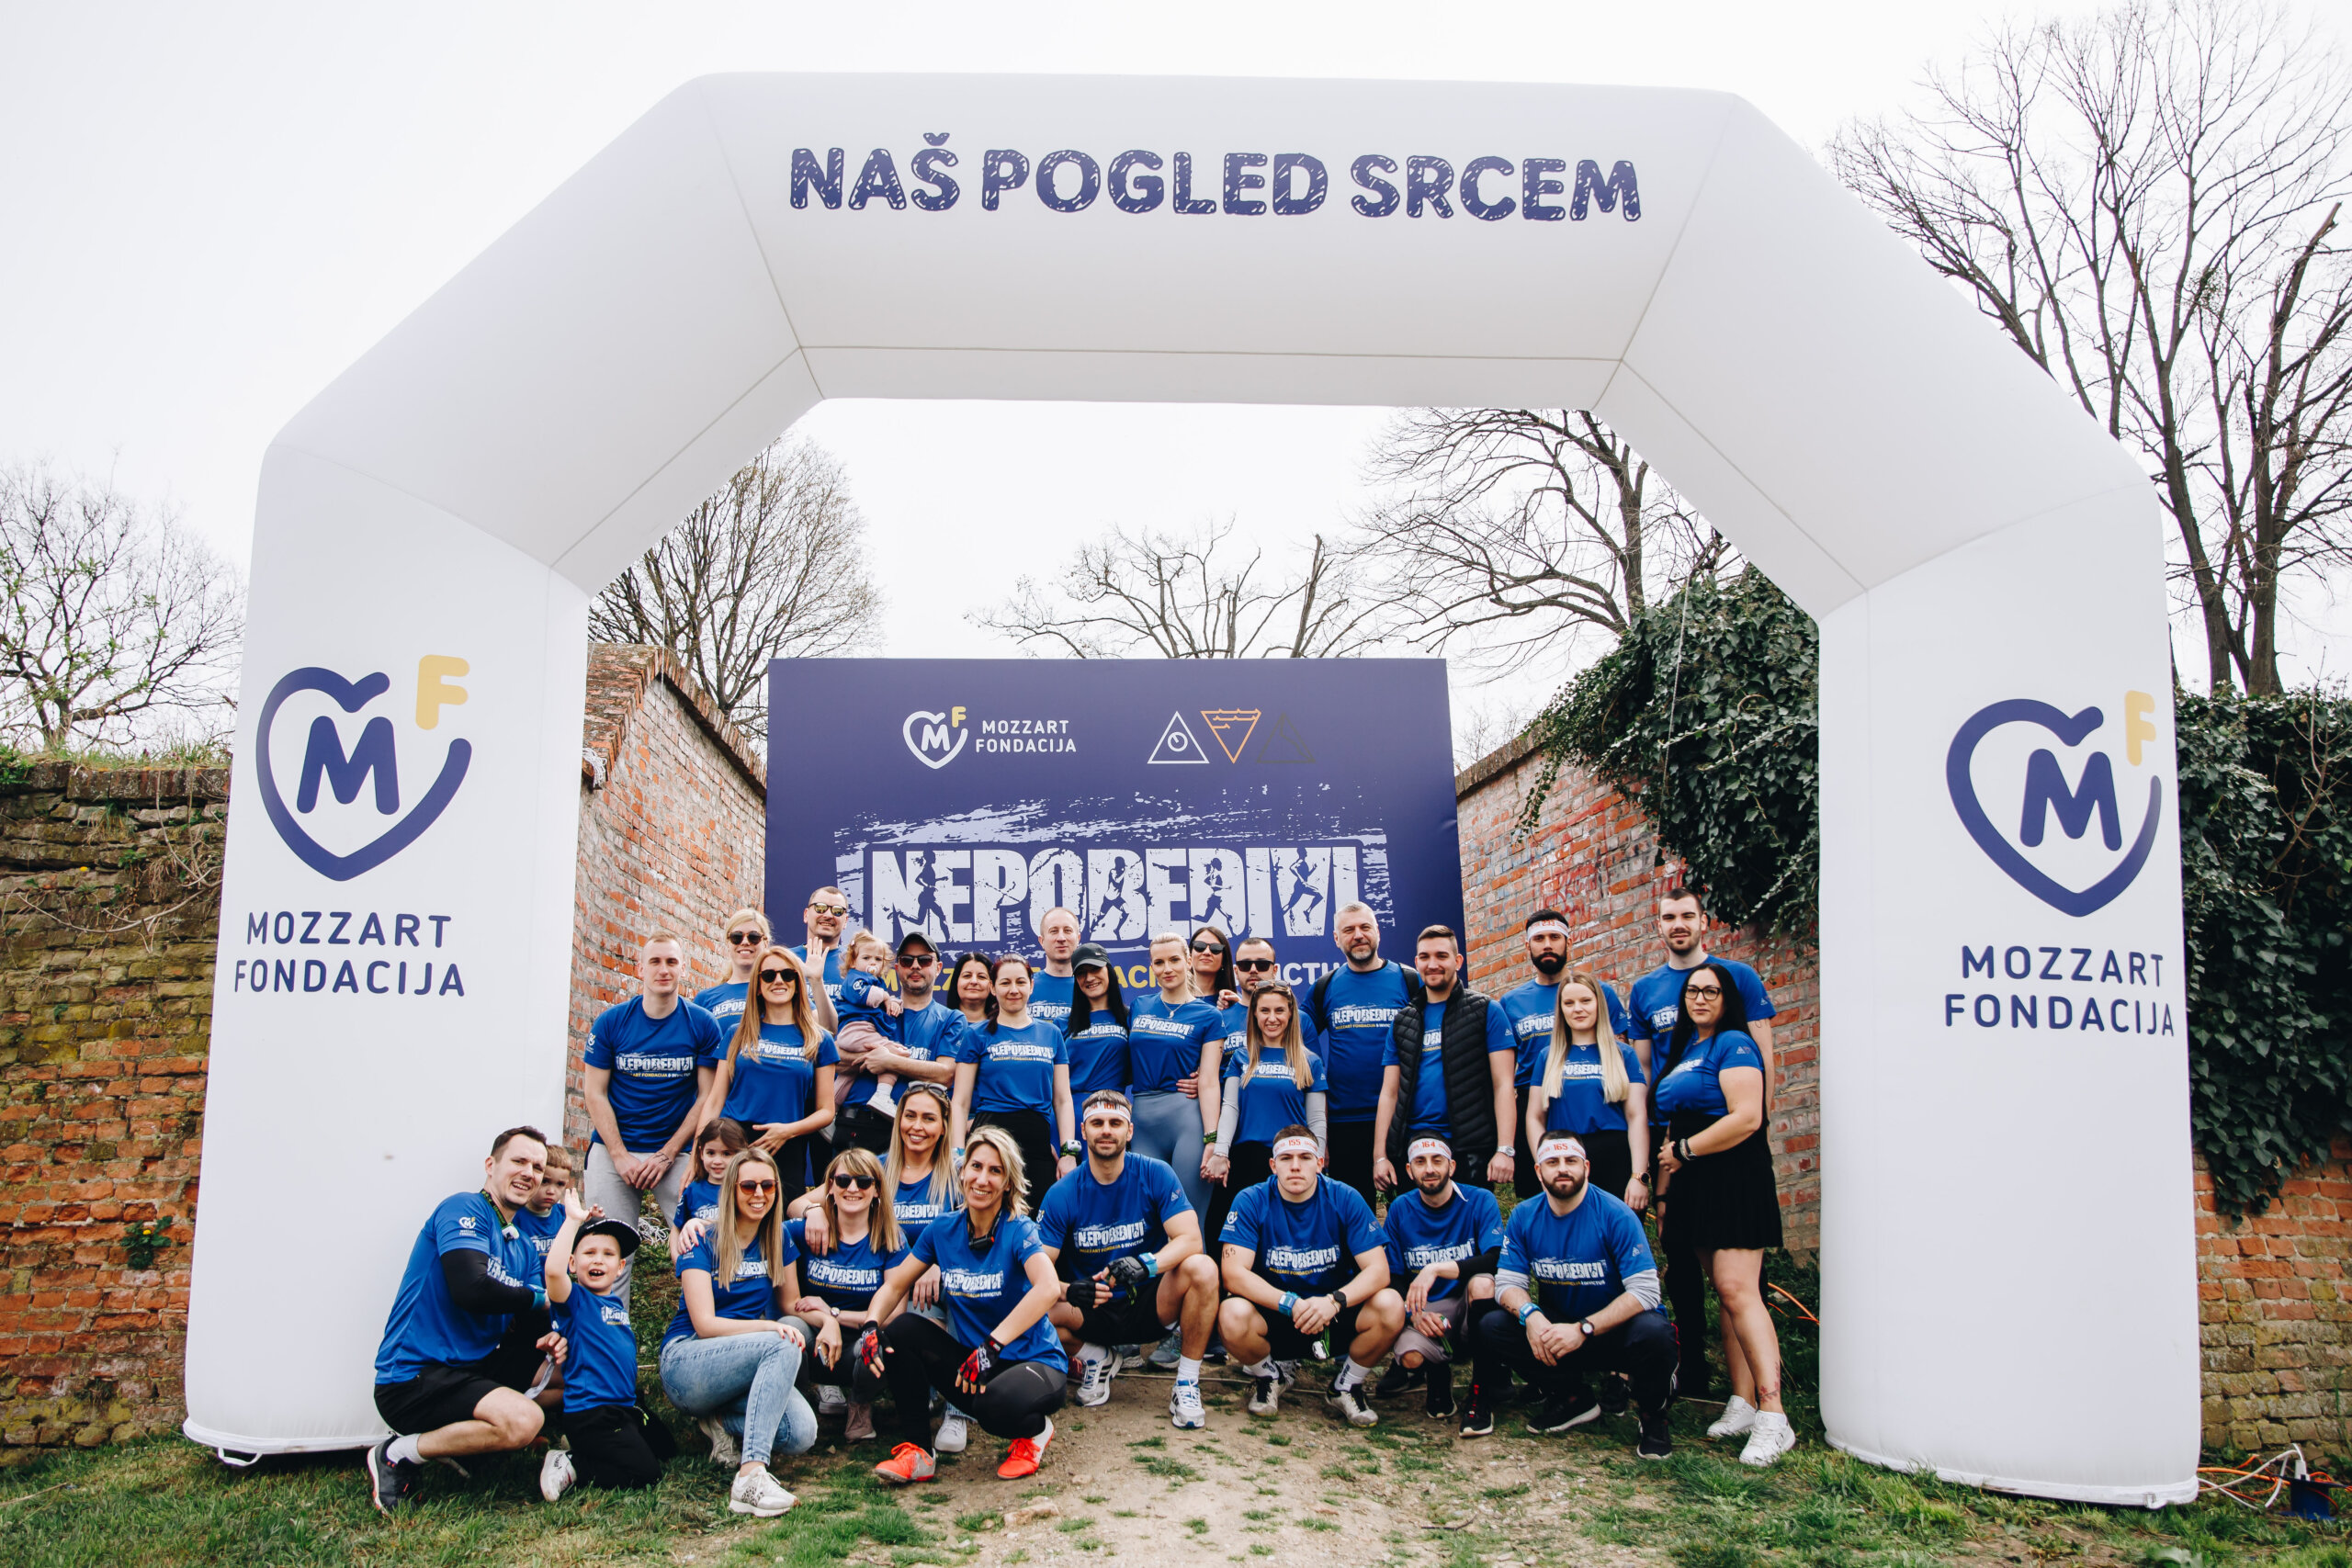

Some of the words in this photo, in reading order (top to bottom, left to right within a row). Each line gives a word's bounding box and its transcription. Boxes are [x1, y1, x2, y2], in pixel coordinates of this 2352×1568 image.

[790, 132, 960, 211] NAŠ
[981, 148, 1328, 215] POGLED
[1351, 153, 1641, 221] SRCEM
[976, 739, 1077, 753] FONDACIJA
[981, 719, 1069, 735] MOZZART
[871, 846, 1362, 944] NEPOBEDIVI
[247, 911, 452, 948] MOZZART
[234, 958, 465, 997] FONDACIJA
[1962, 945, 2163, 987] MOZZART
[1945, 994, 2175, 1037] FONDACIJA
